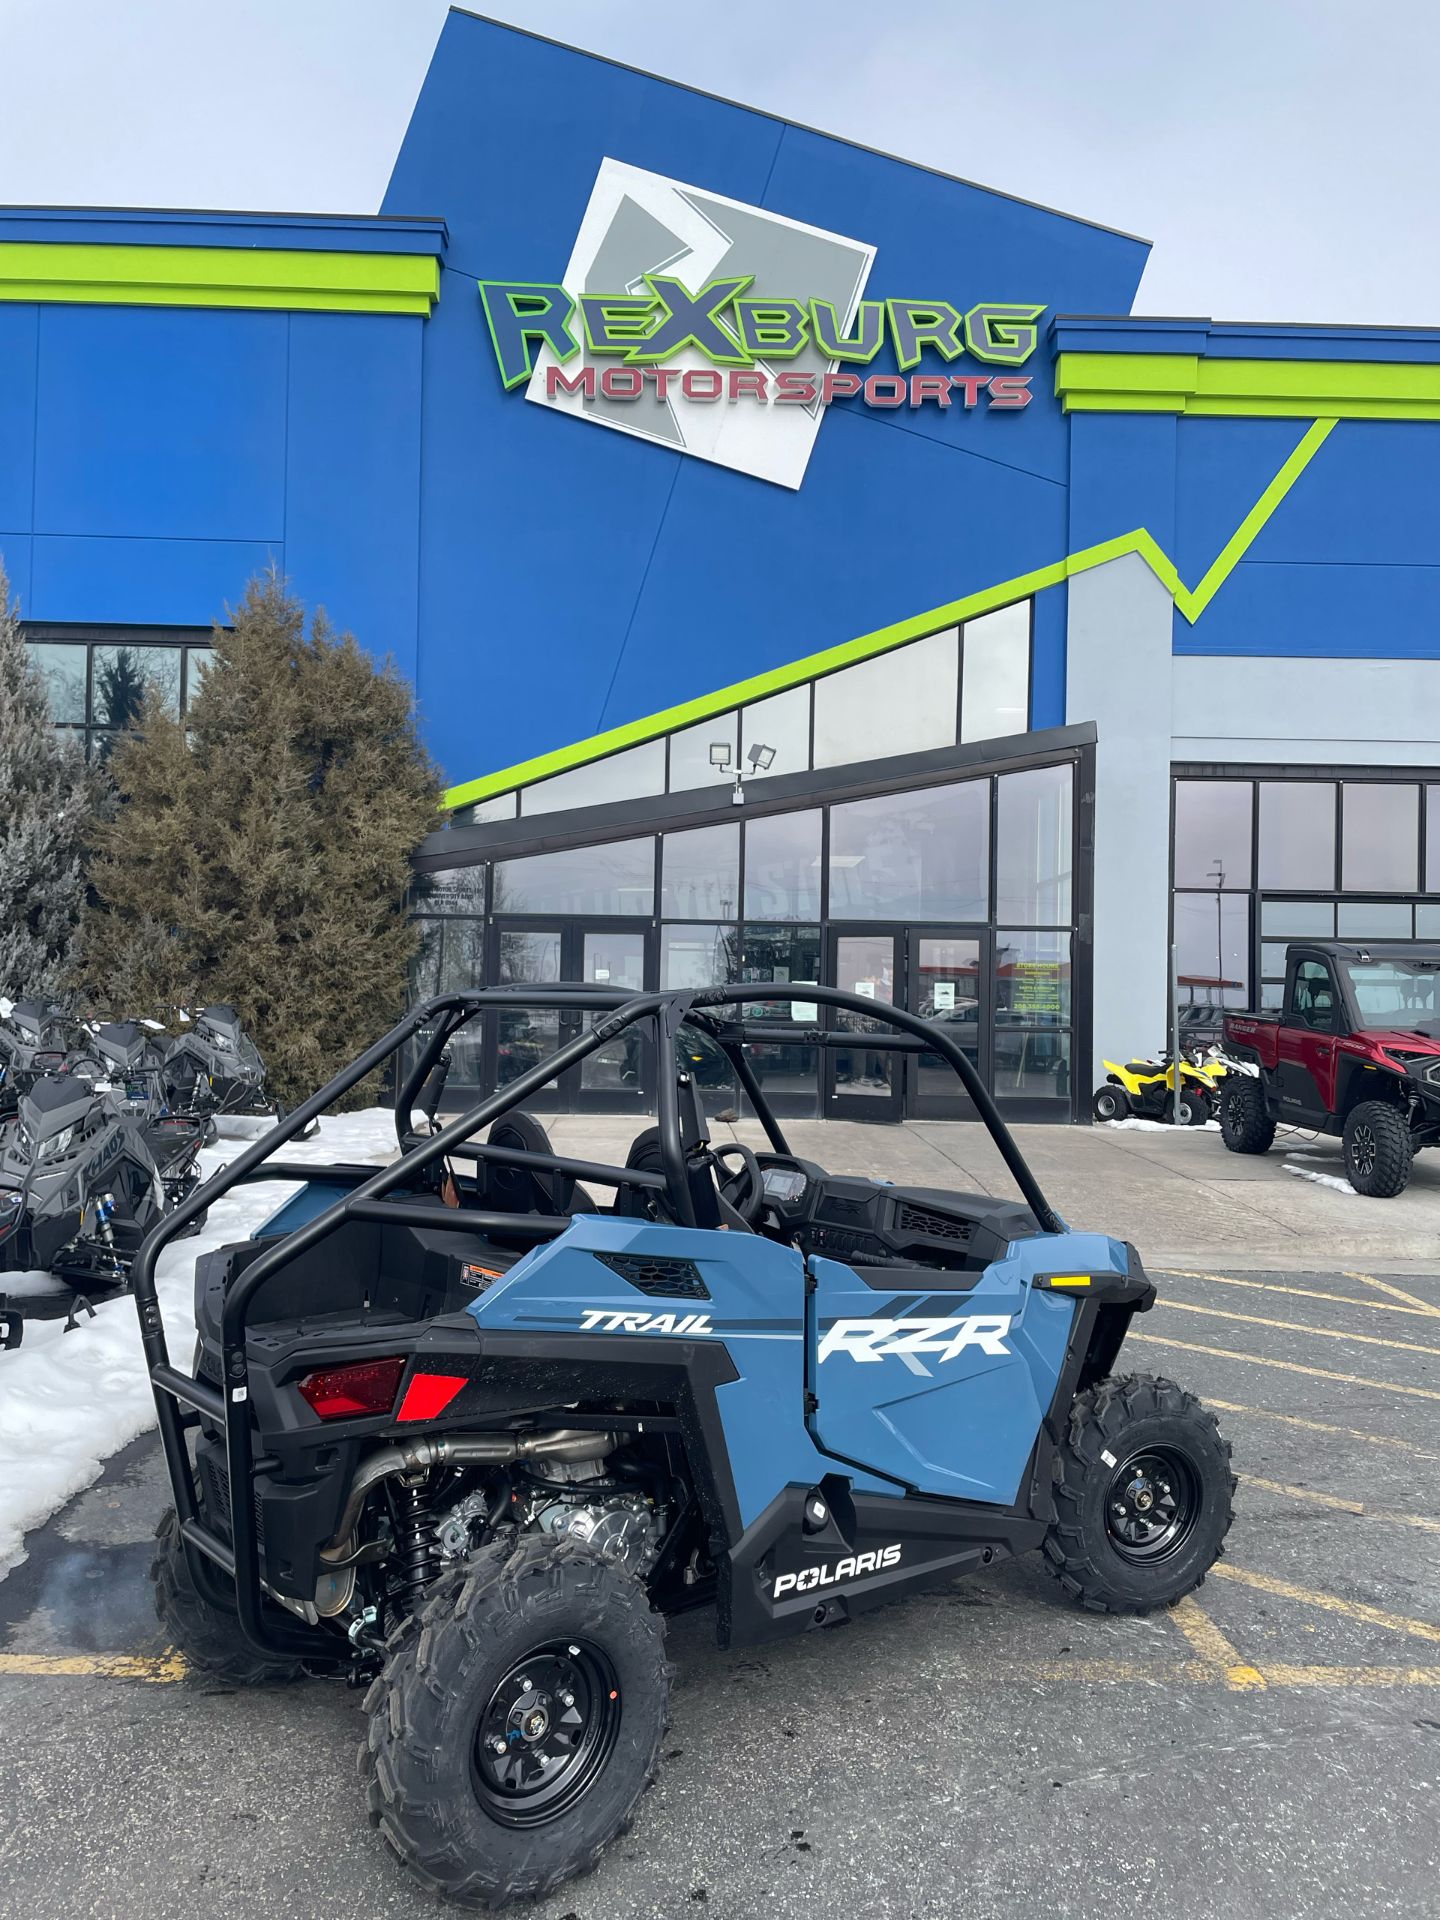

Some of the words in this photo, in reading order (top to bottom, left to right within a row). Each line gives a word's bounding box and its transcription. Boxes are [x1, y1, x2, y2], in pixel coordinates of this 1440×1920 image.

[478, 273, 1048, 391] REXBURG
[547, 366, 1034, 410] MOTORSPORTS
[1229, 1022, 1257, 1034] RANGER
[84, 1126, 125, 1178] KHAOS
[579, 1310, 713, 1334] TRAIL
[818, 1315, 1011, 1365] RZR
[773, 1543, 902, 1598] POLARIS
